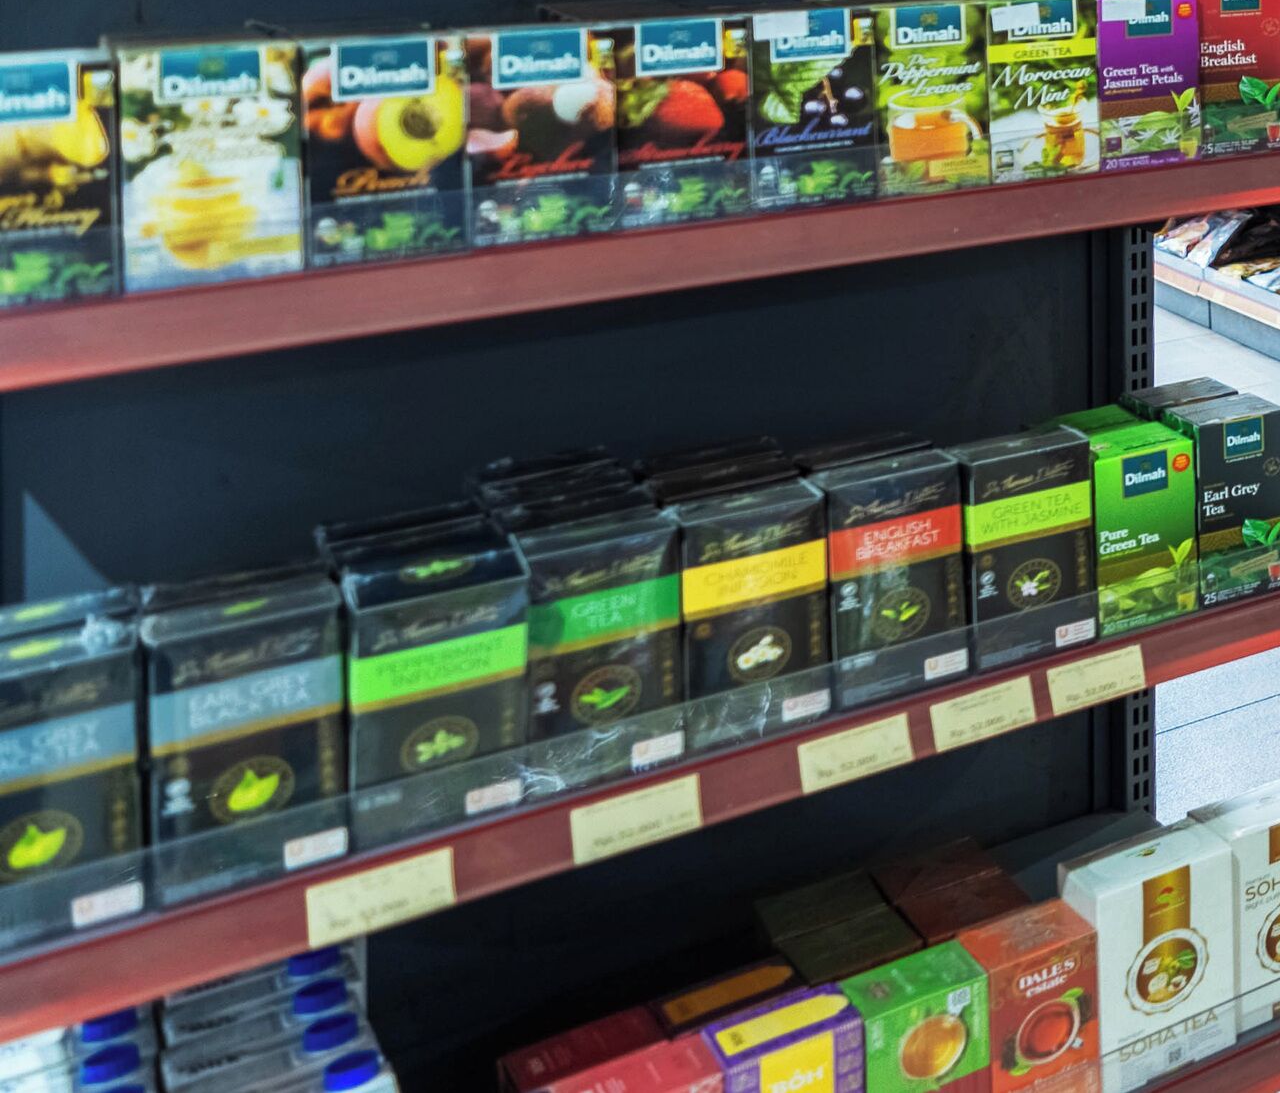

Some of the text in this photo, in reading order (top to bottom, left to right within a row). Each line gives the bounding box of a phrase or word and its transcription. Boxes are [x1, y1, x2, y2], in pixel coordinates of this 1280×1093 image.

[777, 30, 845, 51] Dilmah
[896, 25, 960, 44] Dilmah
[643, 41, 716, 64] Dilmah
[1013, 46, 1073, 60] GREEN TEA
[1200, 38, 1246, 57] English
[500, 51, 581, 77] Dilmah
[1102, 65, 1138, 79] Green
[1139, 63, 1159, 75] Tea
[1200, 52, 1258, 69] Breakfast
[339, 62, 428, 90] Dilmah
[879, 60, 983, 86] Peppermint
[991, 64, 1093, 90] Moroccan
[1102, 72, 1184, 91] Jasmine Petals
[161, 71, 259, 100] Dilmah
[912, 78, 974, 97] Leaves
[1013, 85, 1070, 110] Mint
[754, 116, 874, 147] Blackcurrant
[1200, 143, 1214, 155] 25
[1105, 157, 1118, 170] 20
[1226, 432, 1262, 448] Dilmah
[1124, 467, 1167, 488] Dilmah
[1202, 482, 1261, 504] Earl Grey
[992, 492, 1073, 520] GREEN TEA
[1202, 504, 1226, 518] Tea
[980, 502, 1083, 536] WITH JASMINE
[863, 518, 932, 546] ENGLISH
[1099, 526, 1130, 543] Pure
[855, 529, 941, 562] BREAKFAST
[1099, 531, 1161, 556] Green Tea
[704, 551, 809, 586] CHAMOMILE
[570, 592, 638, 617] GREEN
[1203, 592, 1218, 606] 25
[586, 610, 623, 629] TEA
[1025, 972, 1069, 998] estate
[1119, 1009, 1220, 1063] SOHA TEA
